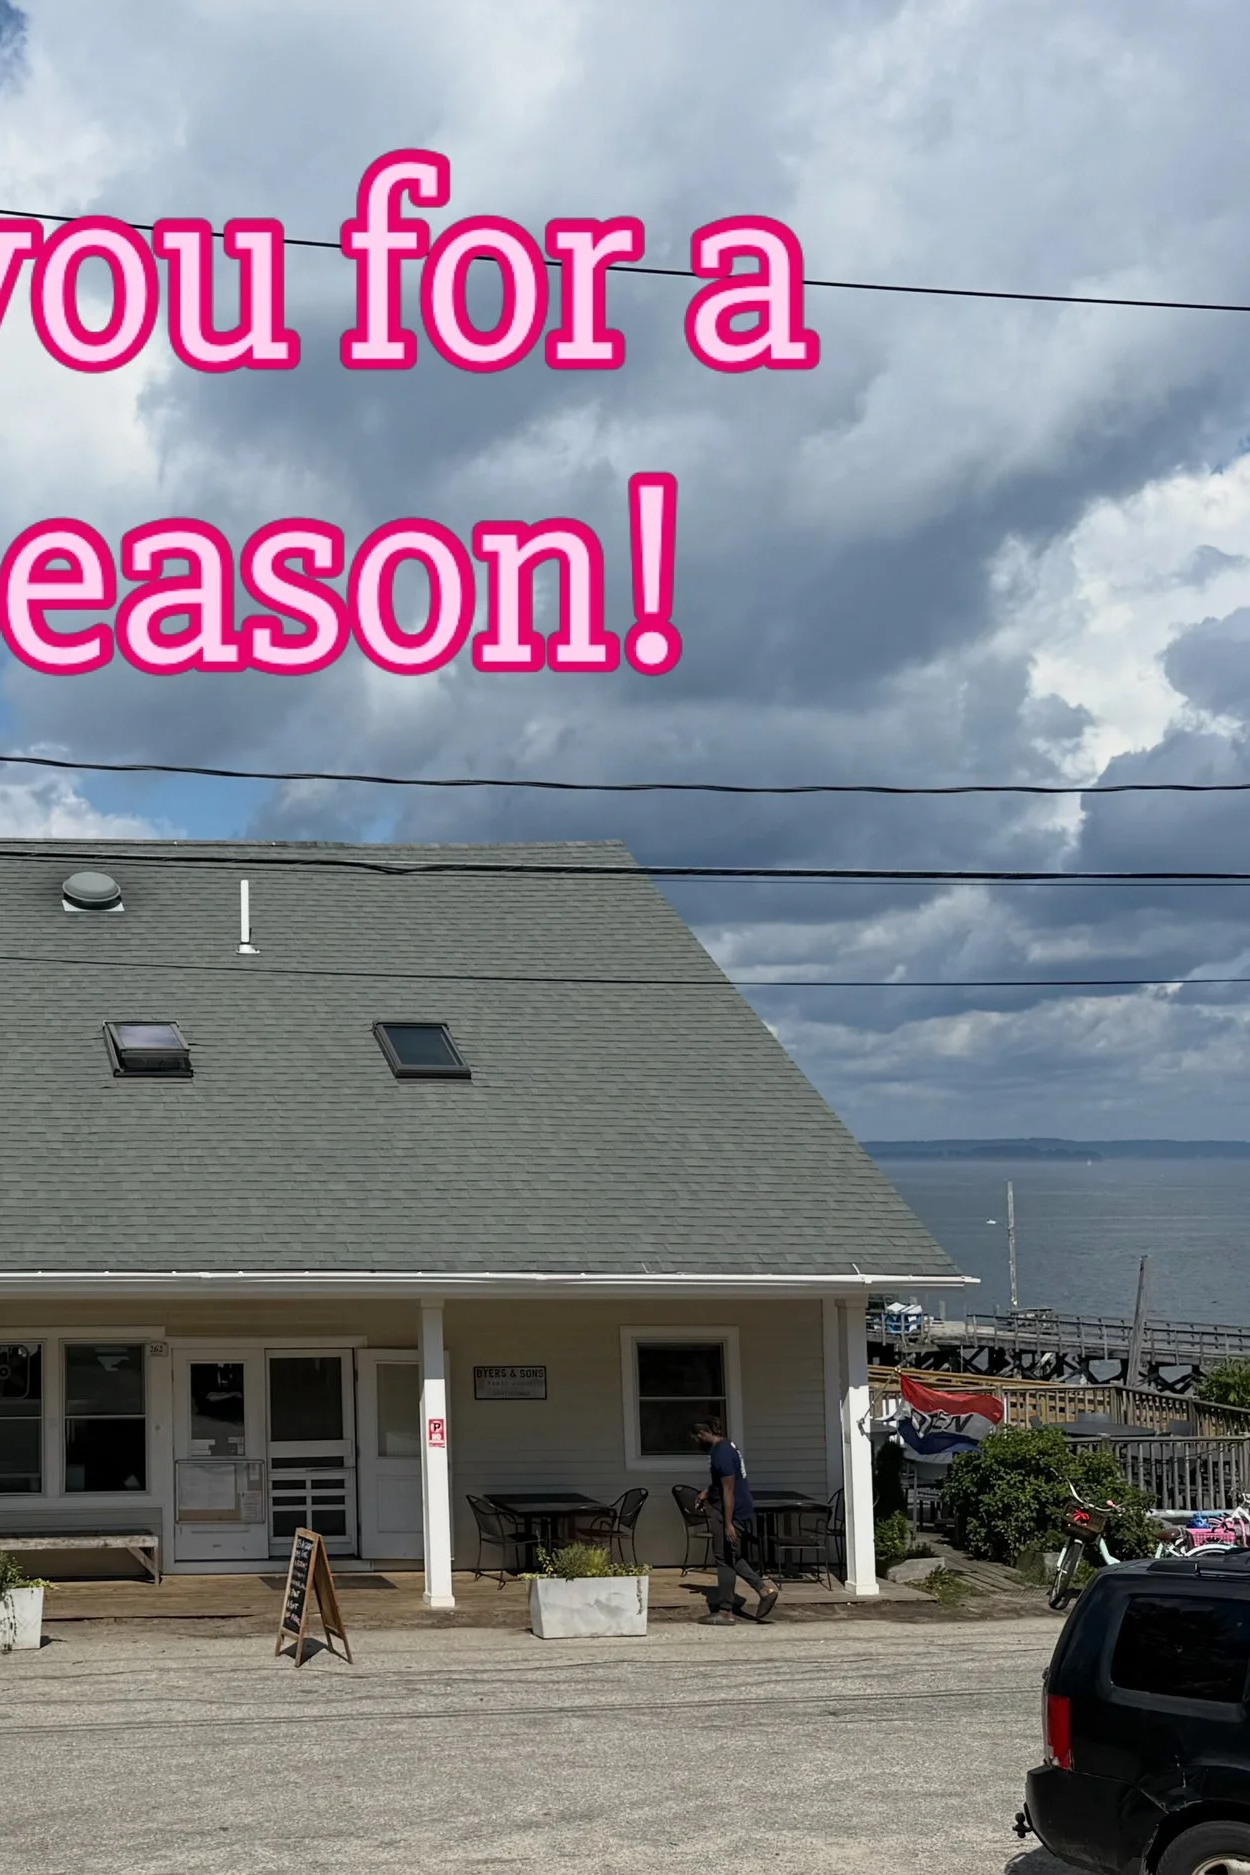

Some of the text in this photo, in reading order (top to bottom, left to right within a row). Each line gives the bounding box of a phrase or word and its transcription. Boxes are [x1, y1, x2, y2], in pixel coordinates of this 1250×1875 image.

[476, 1368, 544, 1379] BYERS & SONS
